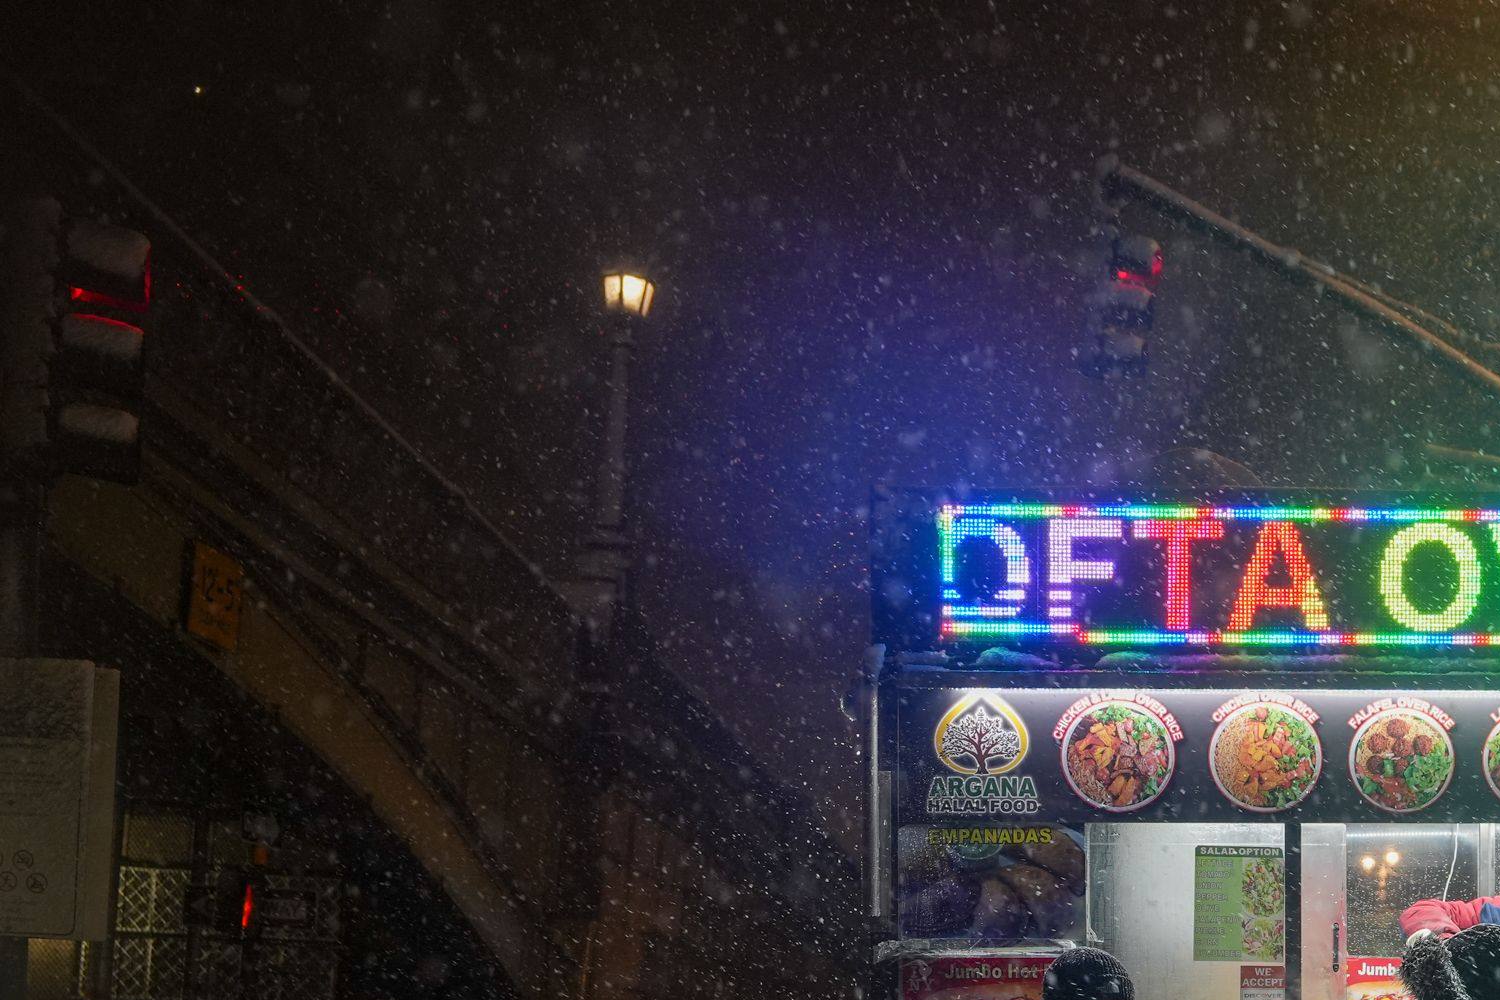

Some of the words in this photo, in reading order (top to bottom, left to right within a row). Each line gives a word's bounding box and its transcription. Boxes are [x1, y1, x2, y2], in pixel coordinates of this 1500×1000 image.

[1053, 696, 1092, 740] CHICKEN
[1135, 693, 1168, 718] OVER
[1163, 714, 1184, 741] RICE
[1292, 699, 1320, 724] RICE
[1347, 697, 1397, 730] FALAFEL
[1397, 695, 1431, 713] OVER
[1429, 704, 1456, 731] RICE
[928, 776, 1037, 798] ARGANA
[927, 799, 987, 813] HALAL
[989, 799, 1039, 813] FOOD
[927, 828, 1052, 844] EMPANADAS
[1200, 847, 1237, 855] SALAD
[1239, 848, 1279, 856] OPTION
[945, 963, 1002, 979] Jumbo
[1008, 963, 1038, 979] Hot
[1255, 968, 1272, 976] WE
[1242, 978, 1285, 987] ACCEPT
